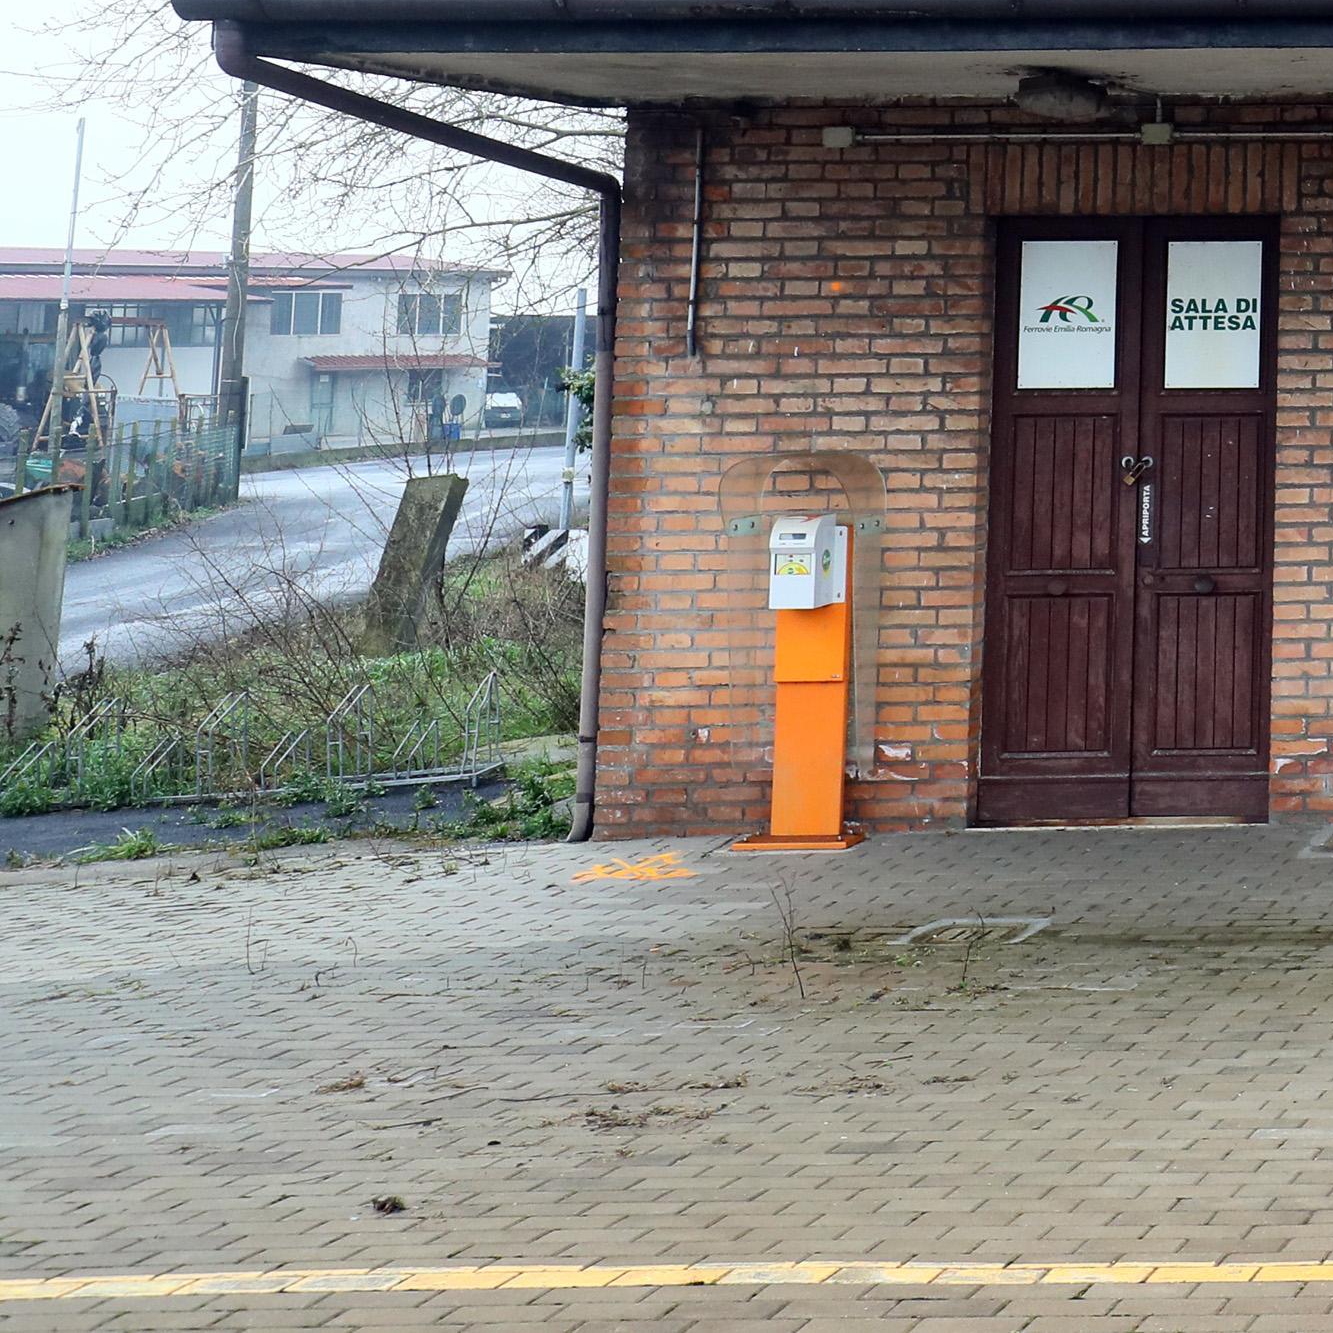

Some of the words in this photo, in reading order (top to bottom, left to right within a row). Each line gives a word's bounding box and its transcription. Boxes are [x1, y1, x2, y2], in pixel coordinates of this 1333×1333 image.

[1170, 298, 1228, 314] SALA
[1236, 298, 1258, 313] DI
[1023, 325, 1053, 333] Ferrovie
[1053, 325, 1075, 333] Emilia
[1076, 325, 1112, 334] Romagna
[1170, 315, 1256, 331] ATTESA
[1142, 485, 1151, 537] APRIPORTA
